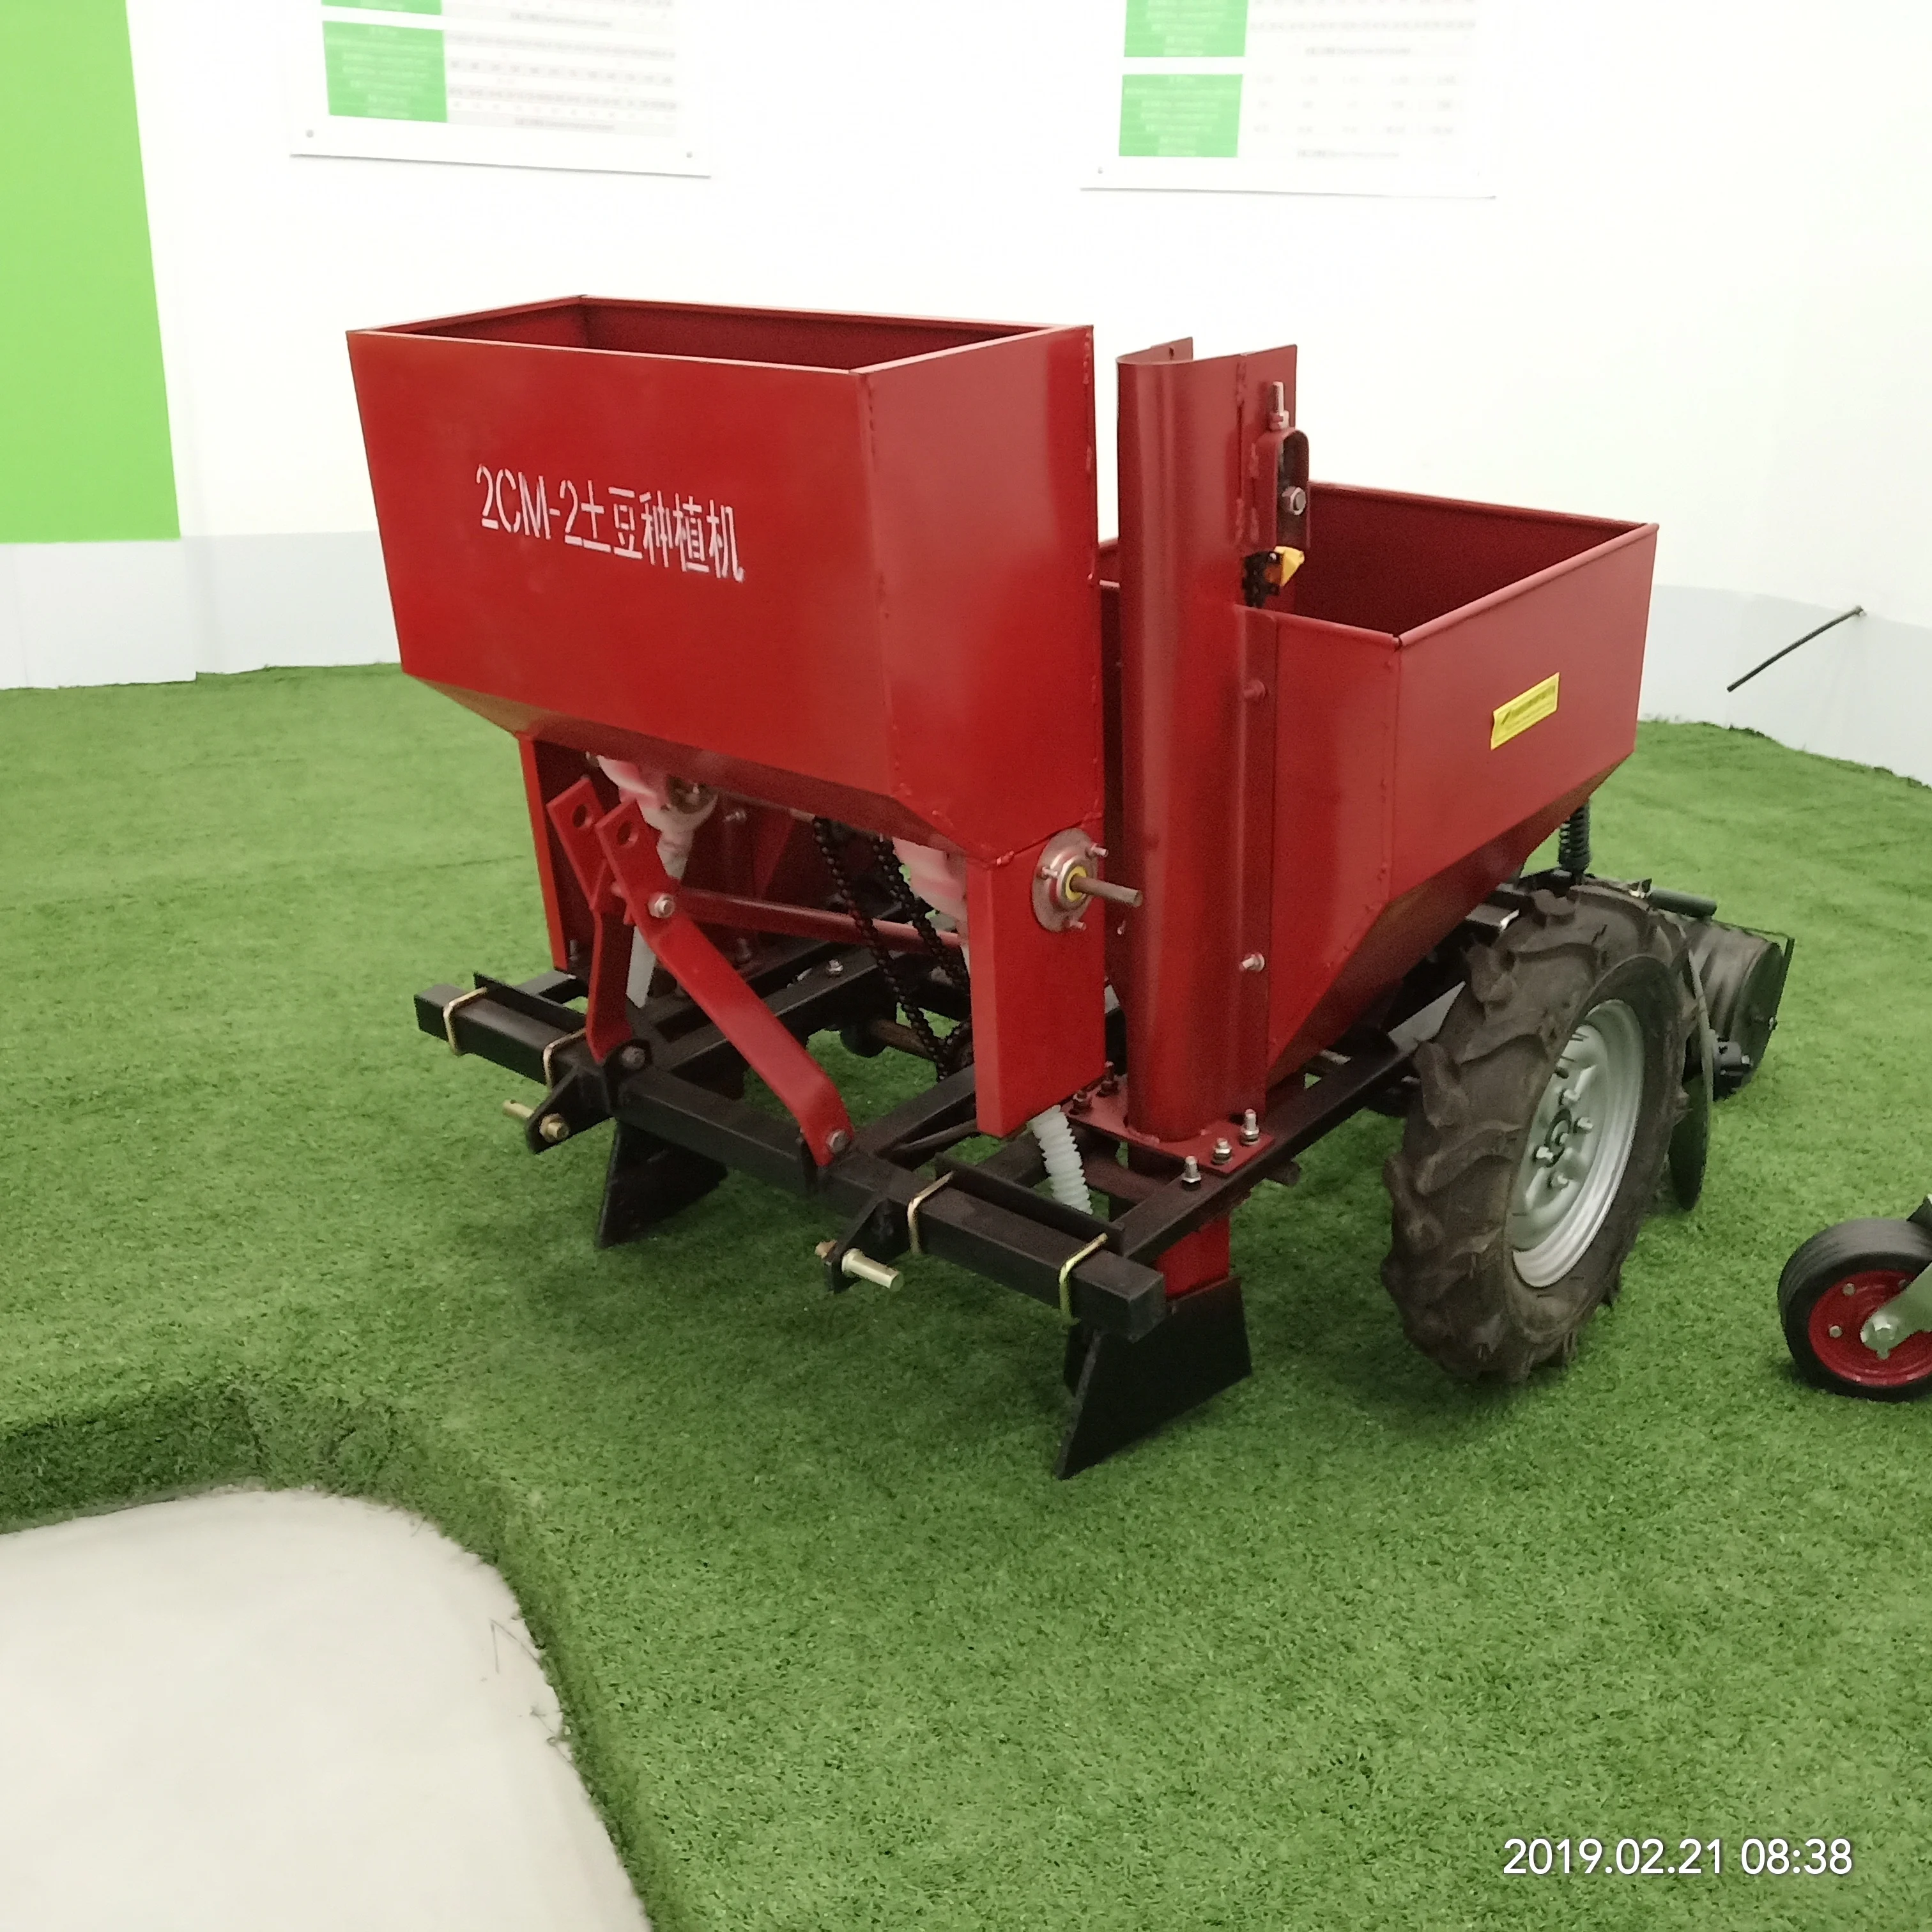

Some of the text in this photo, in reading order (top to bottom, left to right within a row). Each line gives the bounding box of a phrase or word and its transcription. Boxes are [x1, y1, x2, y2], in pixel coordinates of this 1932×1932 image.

[476, 463, 745, 583] 2CM-2土豆种植机
